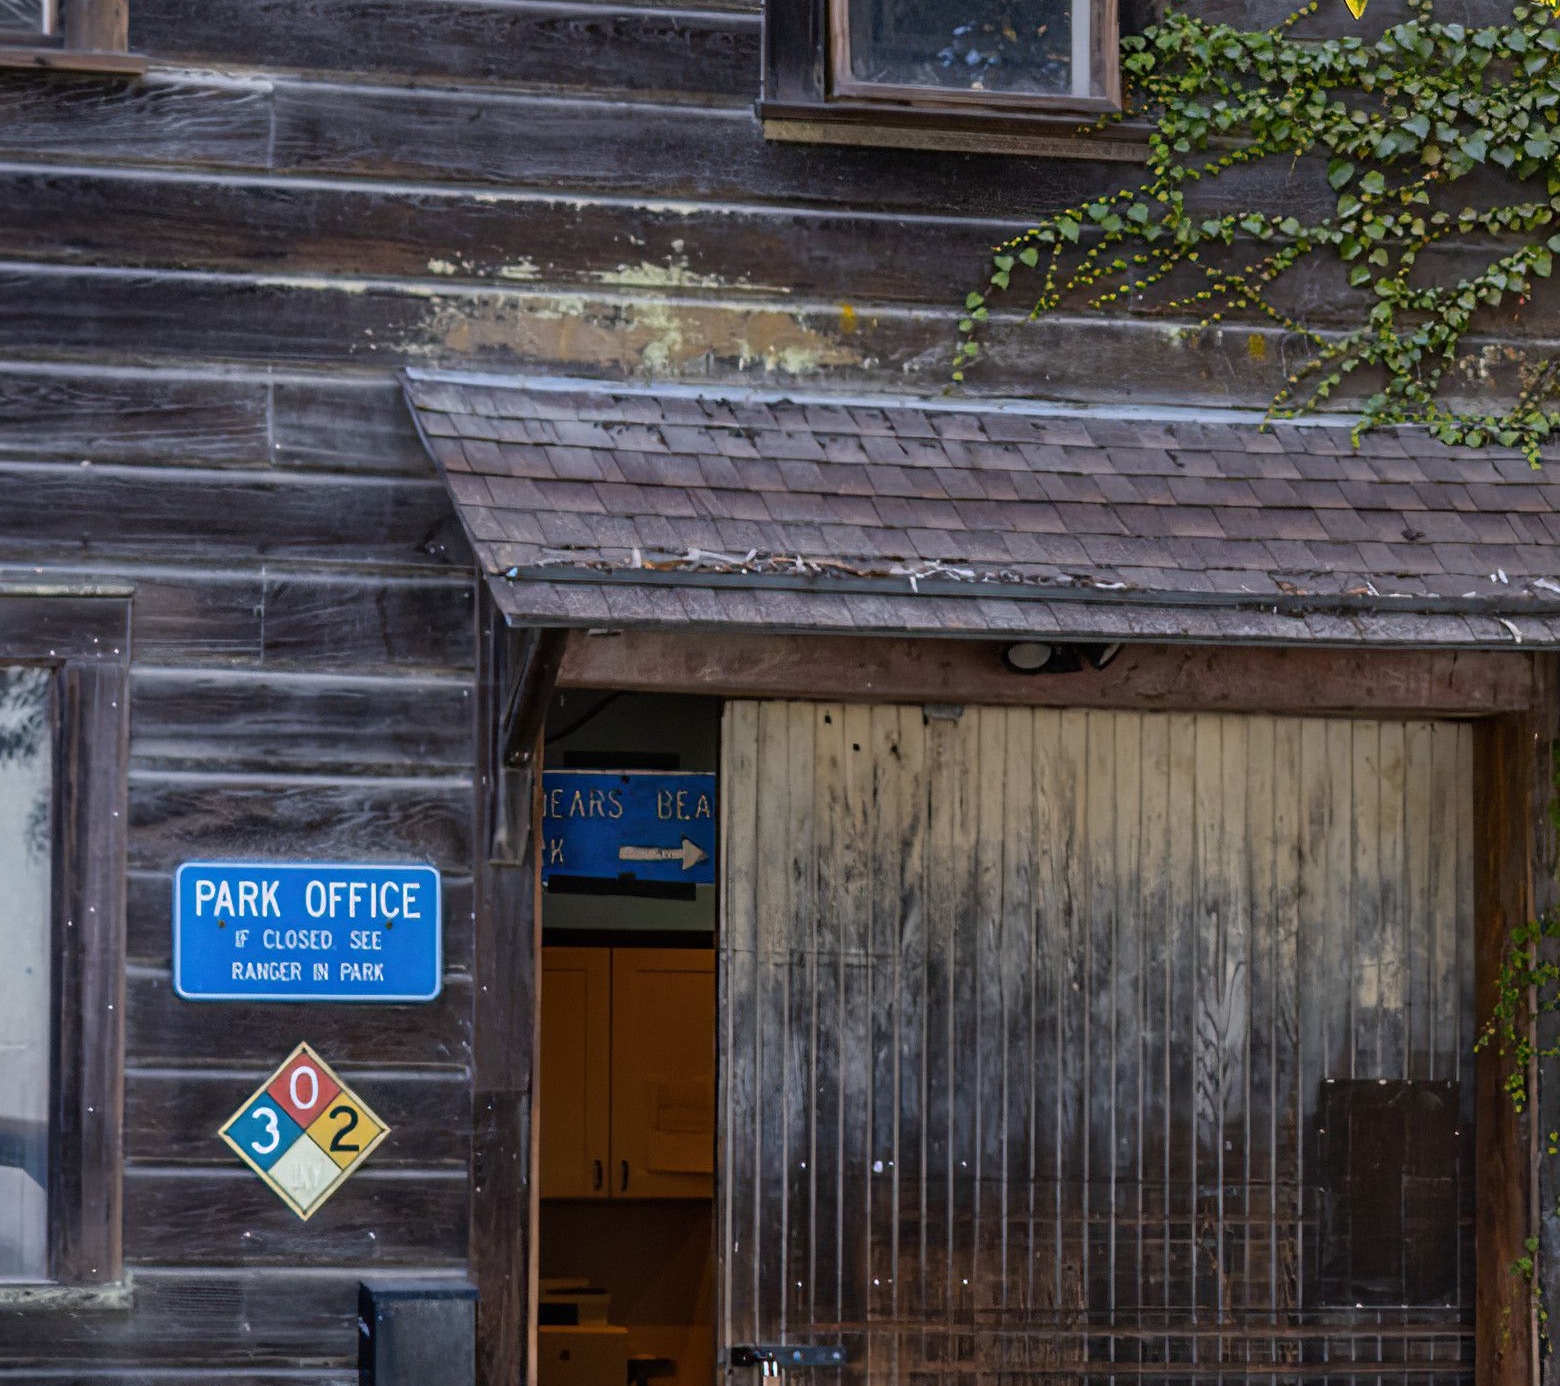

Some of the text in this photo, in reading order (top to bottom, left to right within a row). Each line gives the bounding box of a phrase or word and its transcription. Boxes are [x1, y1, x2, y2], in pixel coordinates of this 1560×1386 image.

[657, 790, 711, 820] BEA
[195, 880, 421, 919] PARK OFFICE
[235, 929, 249, 948] IF
[350, 930, 382, 951] SEE
[231, 961, 384, 982] RANGER IN PARK
[290, 1066, 319, 1109] 0
[251, 1106, 280, 1154] 3
[329, 1105, 360, 1152] 2
